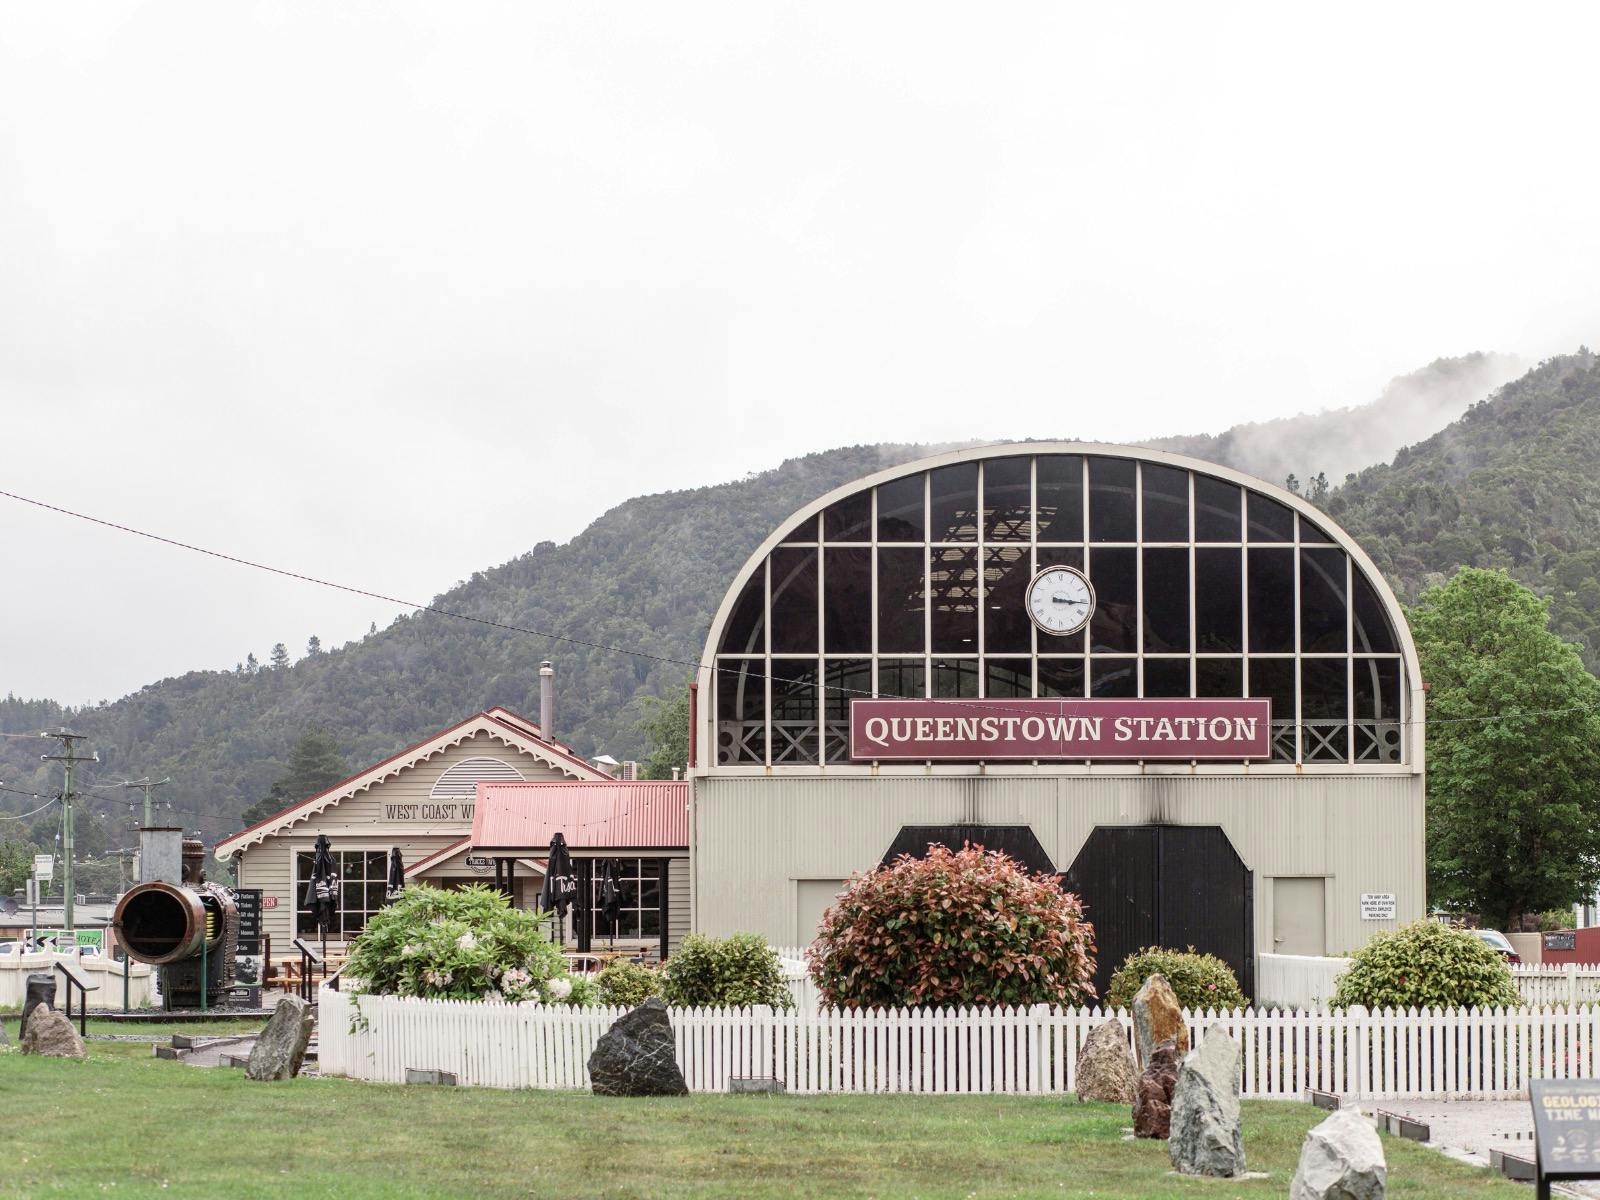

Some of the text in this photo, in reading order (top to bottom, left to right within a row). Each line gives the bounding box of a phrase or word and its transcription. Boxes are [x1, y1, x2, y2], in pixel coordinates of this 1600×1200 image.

[864, 716, 1258, 746] QUEENSTOWN STATION
[385, 804, 418, 820] WEST
[422, 804, 457, 820] COAST
[262, 897, 275, 907] PEN
[1545, 1108, 1583, 1121] TIME
